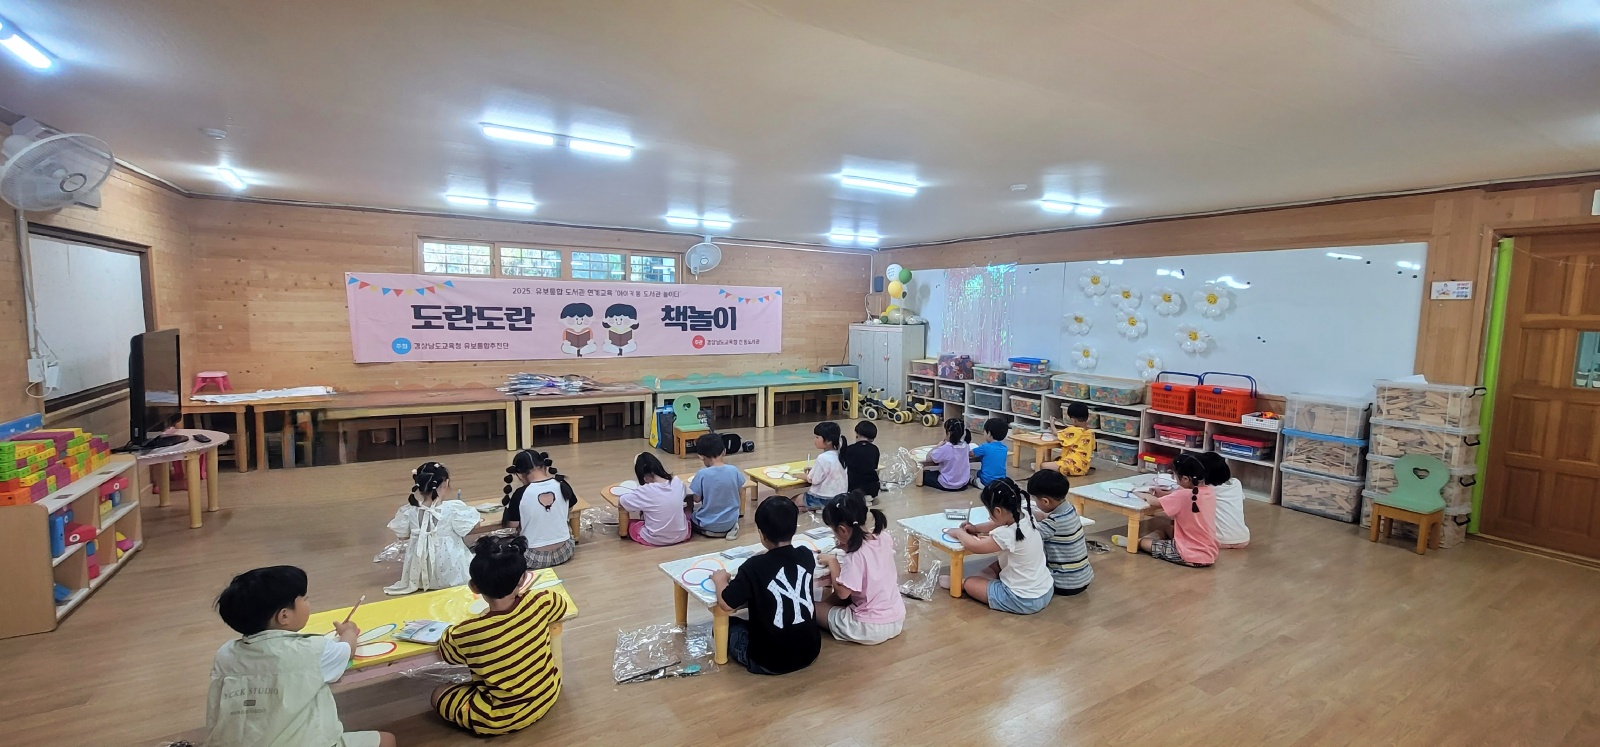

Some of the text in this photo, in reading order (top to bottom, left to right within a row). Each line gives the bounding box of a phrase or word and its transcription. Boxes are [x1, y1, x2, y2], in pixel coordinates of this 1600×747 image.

[535, 287, 564, 296] 유보통합
[565, 288, 585, 297] 도서관
[587, 288, 613, 297] 연계교육
[643, 290, 661, 298] 도서관
[410, 304, 737, 332] 도란도란 책놀이
[413, 342, 509, 350] 경상남도교육청 유보통합추진단
[767, 564, 814, 629] NY
[248, 687, 279, 695] STUDIO
